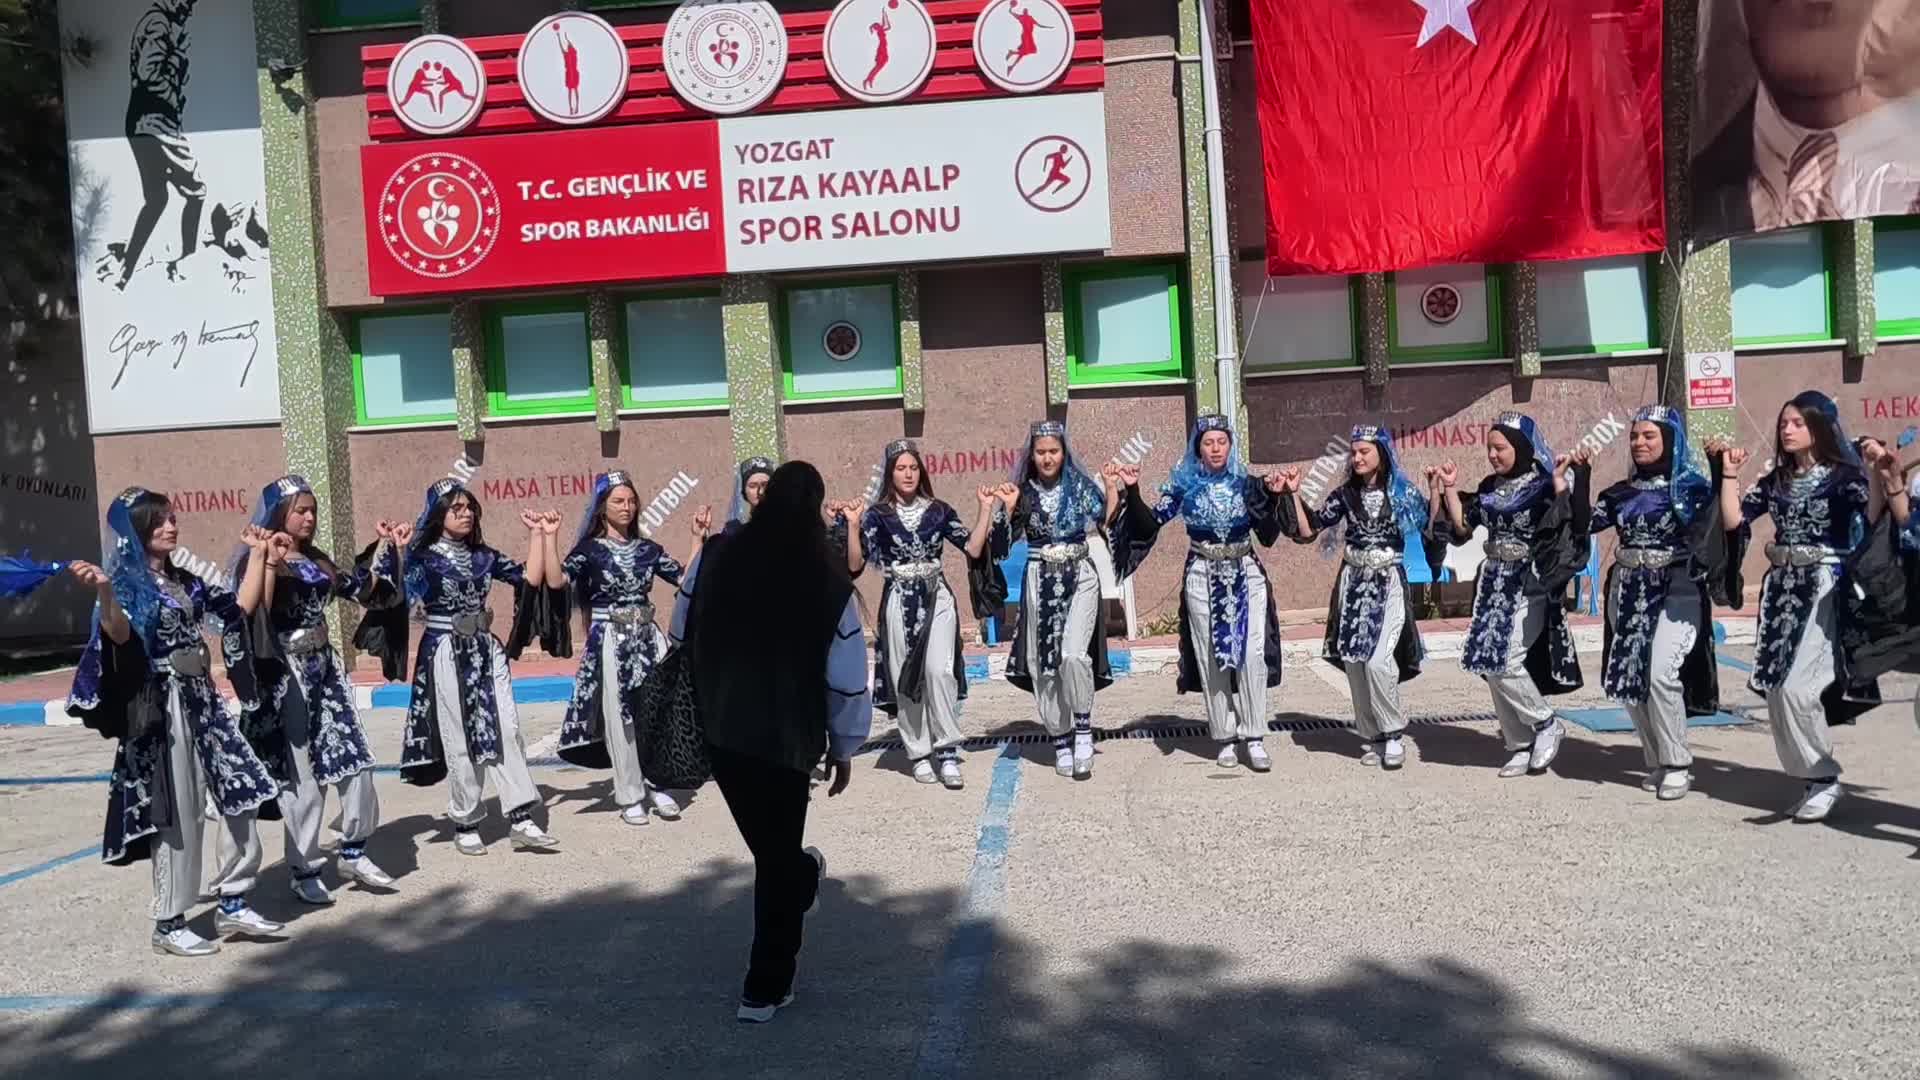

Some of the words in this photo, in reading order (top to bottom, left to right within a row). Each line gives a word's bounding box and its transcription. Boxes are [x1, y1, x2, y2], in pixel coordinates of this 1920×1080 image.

[734, 138, 835, 165] YOZGAT
[517, 180, 562, 201] T.C.
[567, 168, 673, 199] GENÇLİK
[680, 169, 708, 190] VE
[737, 175, 810, 204] RIZA
[818, 164, 961, 199] KAYAALP
[520, 221, 581, 243] SPOR
[585, 207, 710, 237] BAKANLIĞI
[739, 216, 823, 246] SPOR
[831, 206, 961, 240] SALONU
[482, 476, 540, 501] MASA
[547, 468, 602, 498] TENİ
[166, 488, 248, 515] ATRANÇ
